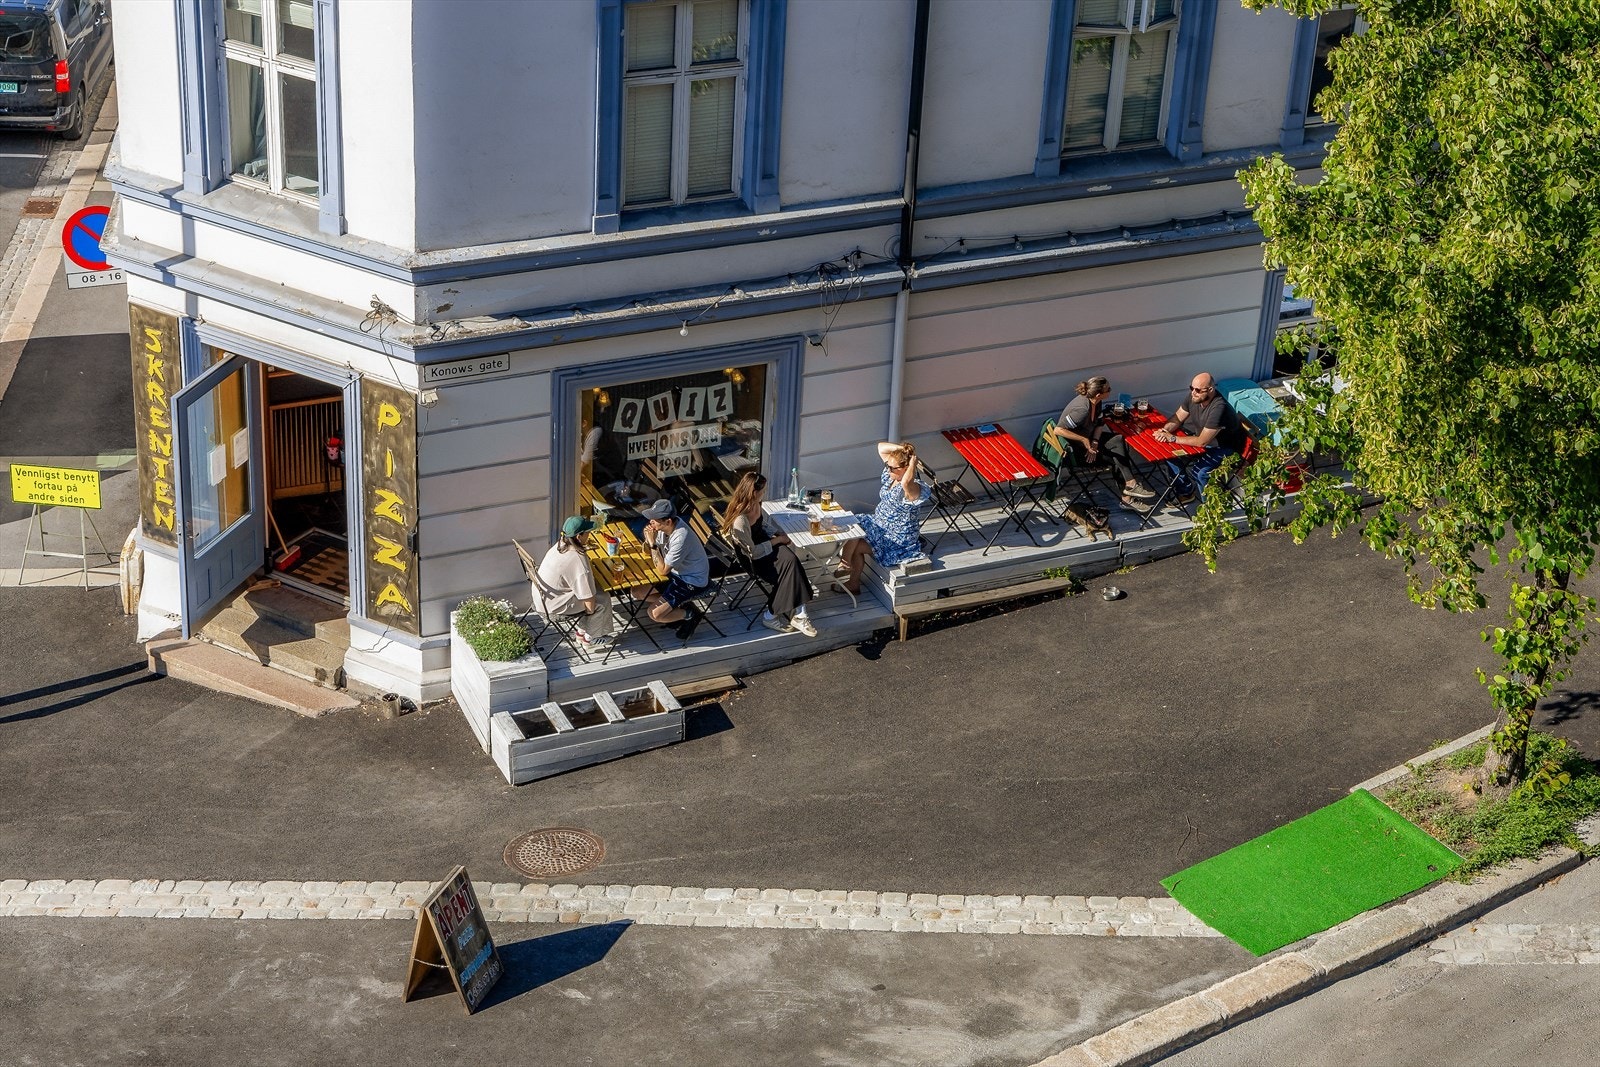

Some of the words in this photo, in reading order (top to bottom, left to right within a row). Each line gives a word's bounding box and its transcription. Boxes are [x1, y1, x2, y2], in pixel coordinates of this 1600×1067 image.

[0, 82, 16, 91] 090
[81, 275, 97, 283] 08
[108, 272, 122, 281] 16
[431, 364, 473, 378] Konows
[479, 360, 503, 373] gate
[620, 387, 727, 430] QUIZ
[144, 327, 176, 532] SKRENTEN
[628, 438, 656, 455] HVER
[658, 454, 689, 472] 19:00
[15, 467, 61, 480] Vennligst
[63, 471, 96, 484] benytt
[33, 480, 63, 491] fortau
[66, 483, 78, 494] på
[28, 492, 56, 502] andre
[59, 494, 85, 504] siden
[373, 402, 412, 613] PIZZA
[433, 880, 477, 941] ÅPENT
